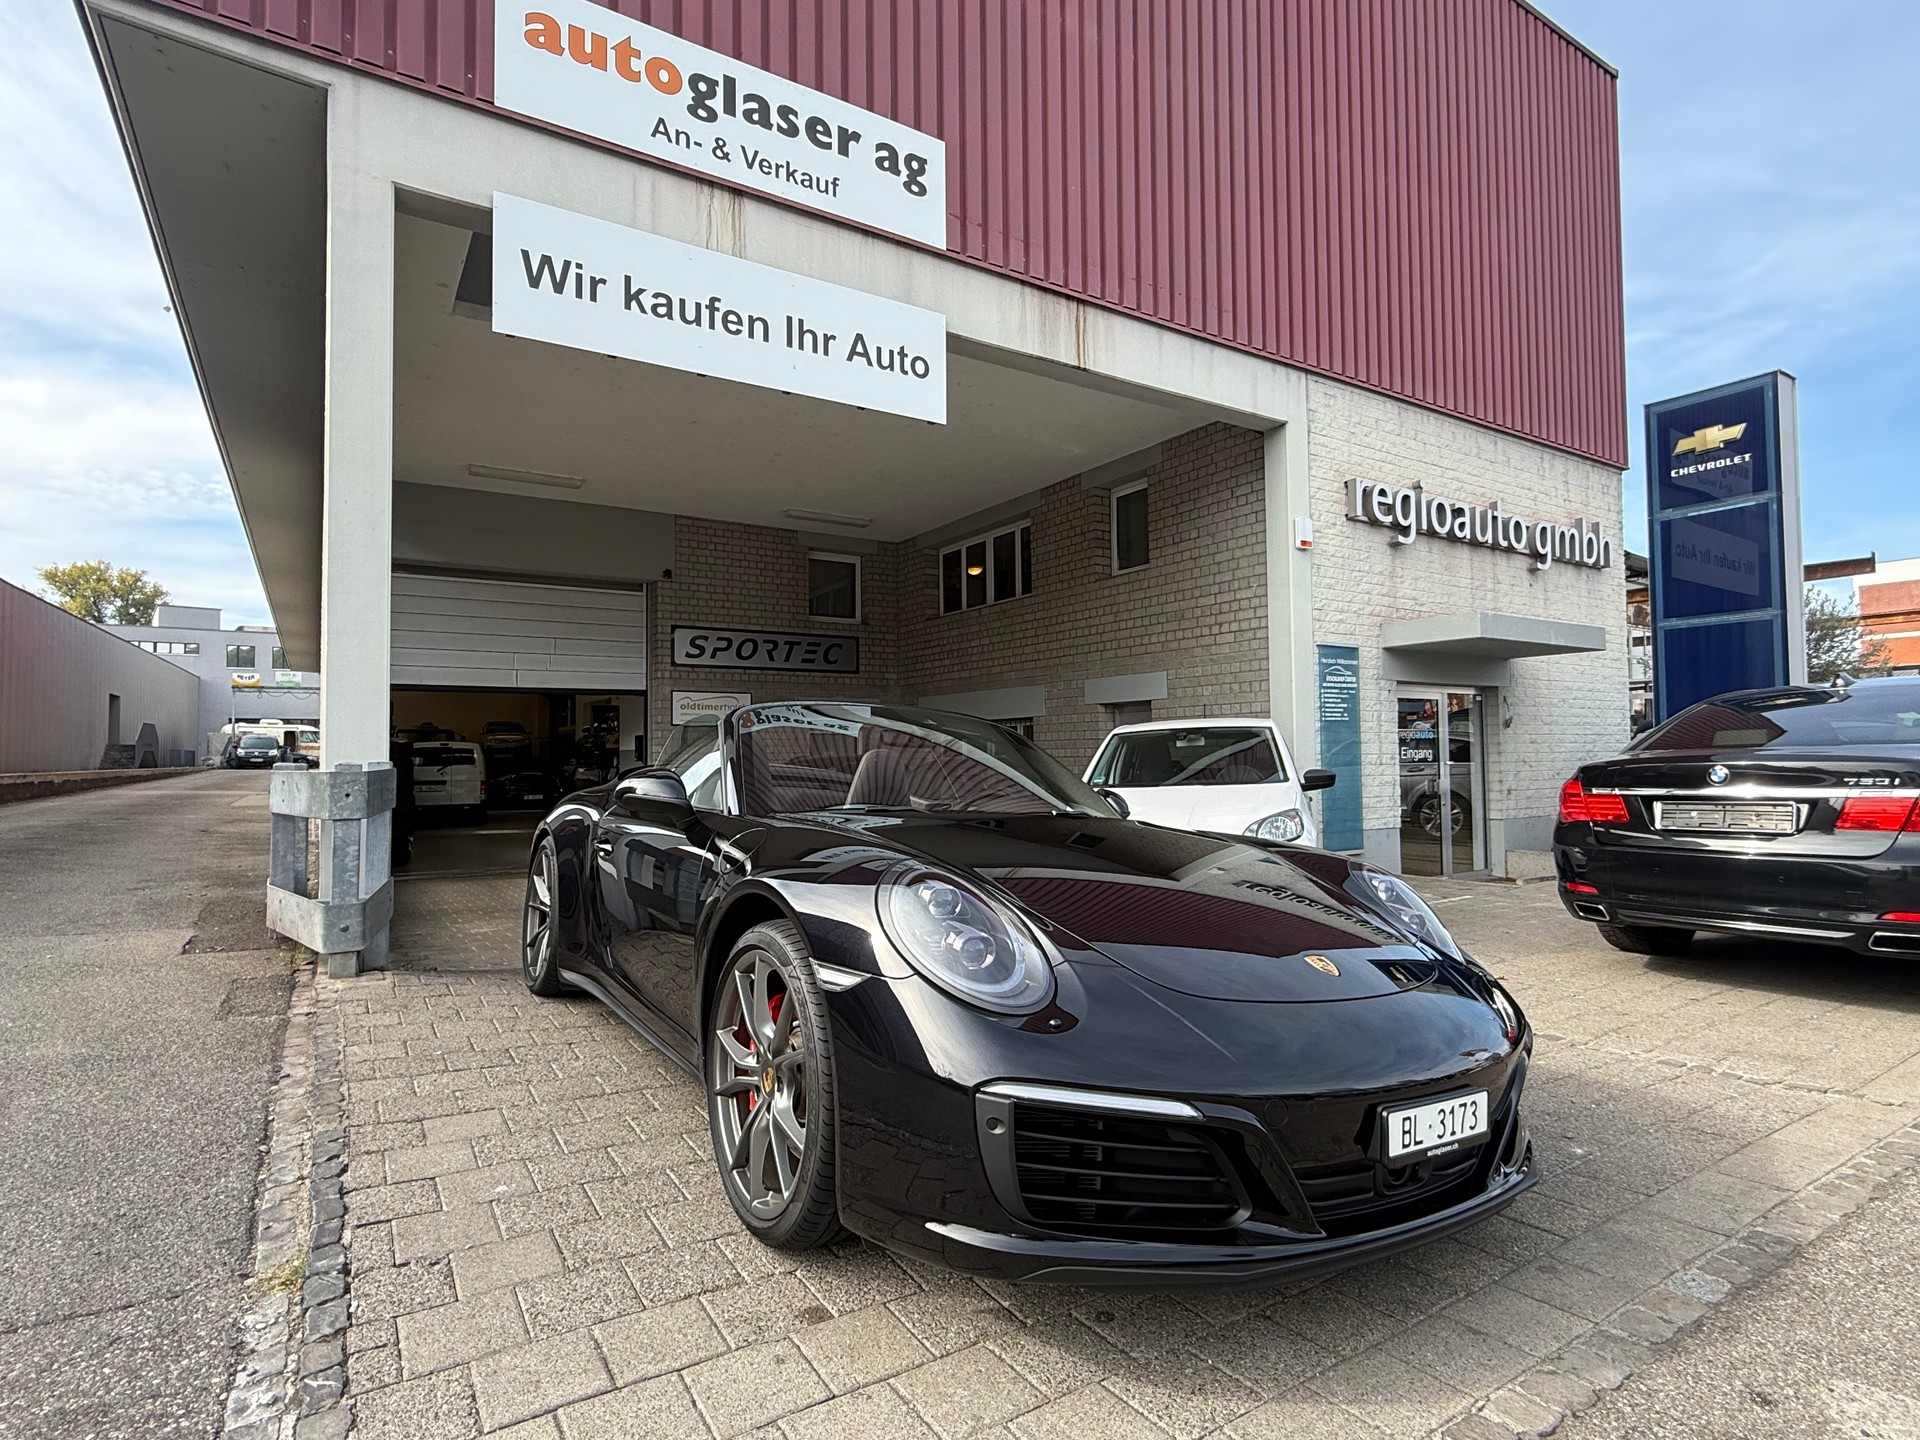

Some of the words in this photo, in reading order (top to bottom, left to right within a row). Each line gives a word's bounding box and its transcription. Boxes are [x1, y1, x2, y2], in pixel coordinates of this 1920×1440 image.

[523, 11, 862, 159] autoglaser
[874, 141, 928, 197] ag
[650, 117, 703, 150] An-
[711, 137, 732, 163] &
[740, 145, 840, 198] Verkauf
[520, 248, 607, 303] Wir
[623, 274, 770, 343] kaufen
[785, 315, 837, 356] Ihr
[846, 332, 930, 379] Auto
[1670, 453, 1752, 478] CHEVROLET
[1346, 477, 1528, 551] regioauto
[1530, 517, 1613, 572] gmbh
[684, 634, 844, 666] SPORTEC
[1401, 746, 1433, 762] Eingang
[1402, 1114, 1423, 1150] BL
[1437, 1101, 1477, 1139] 3173
